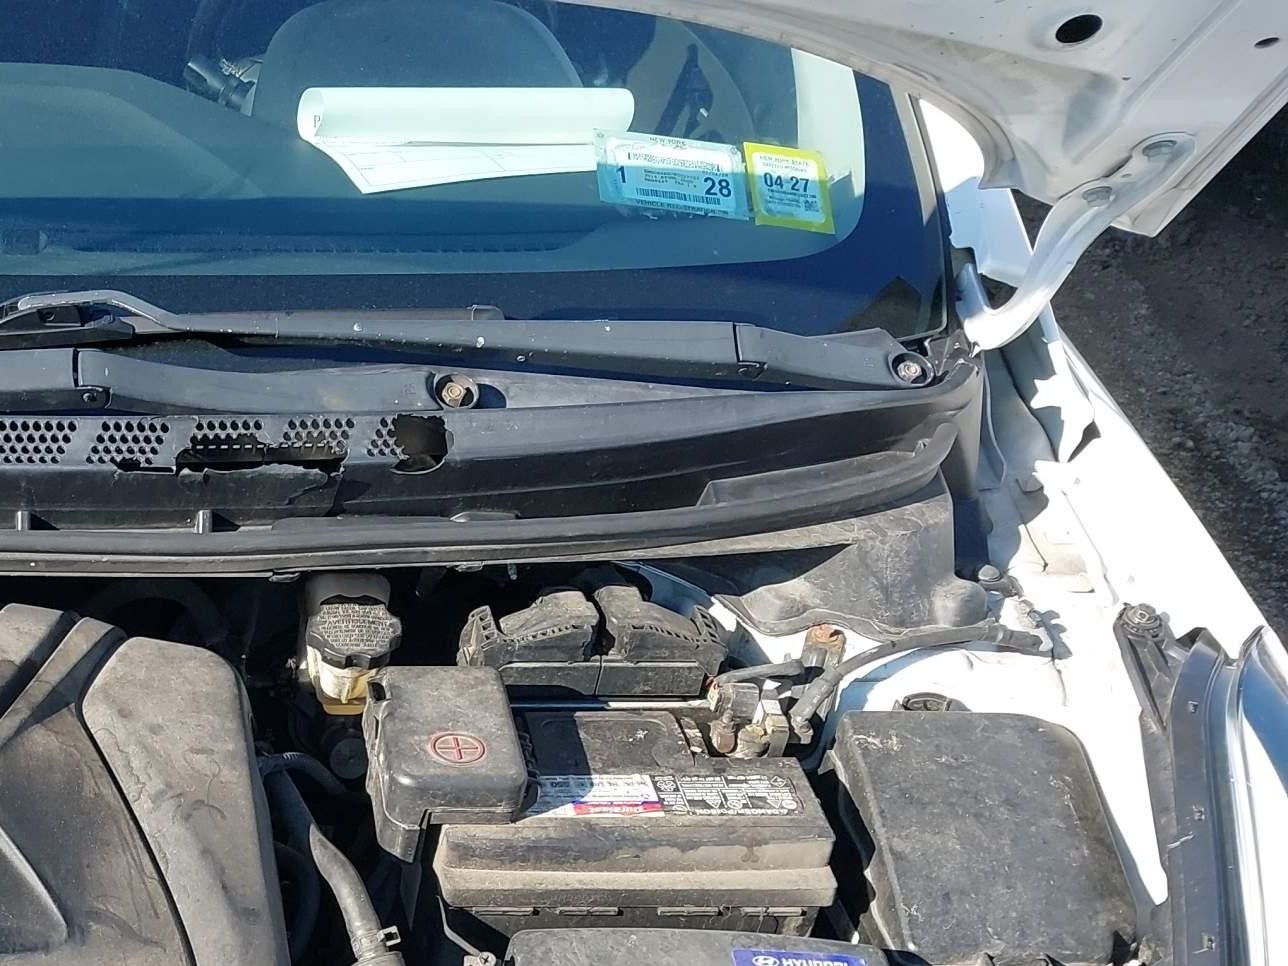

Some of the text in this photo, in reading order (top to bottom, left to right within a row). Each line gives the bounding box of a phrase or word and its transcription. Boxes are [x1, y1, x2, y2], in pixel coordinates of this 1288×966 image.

[615, 165, 627, 184] 1
[763, 172, 810, 193] 04 27
[703, 176, 732, 198] 28
